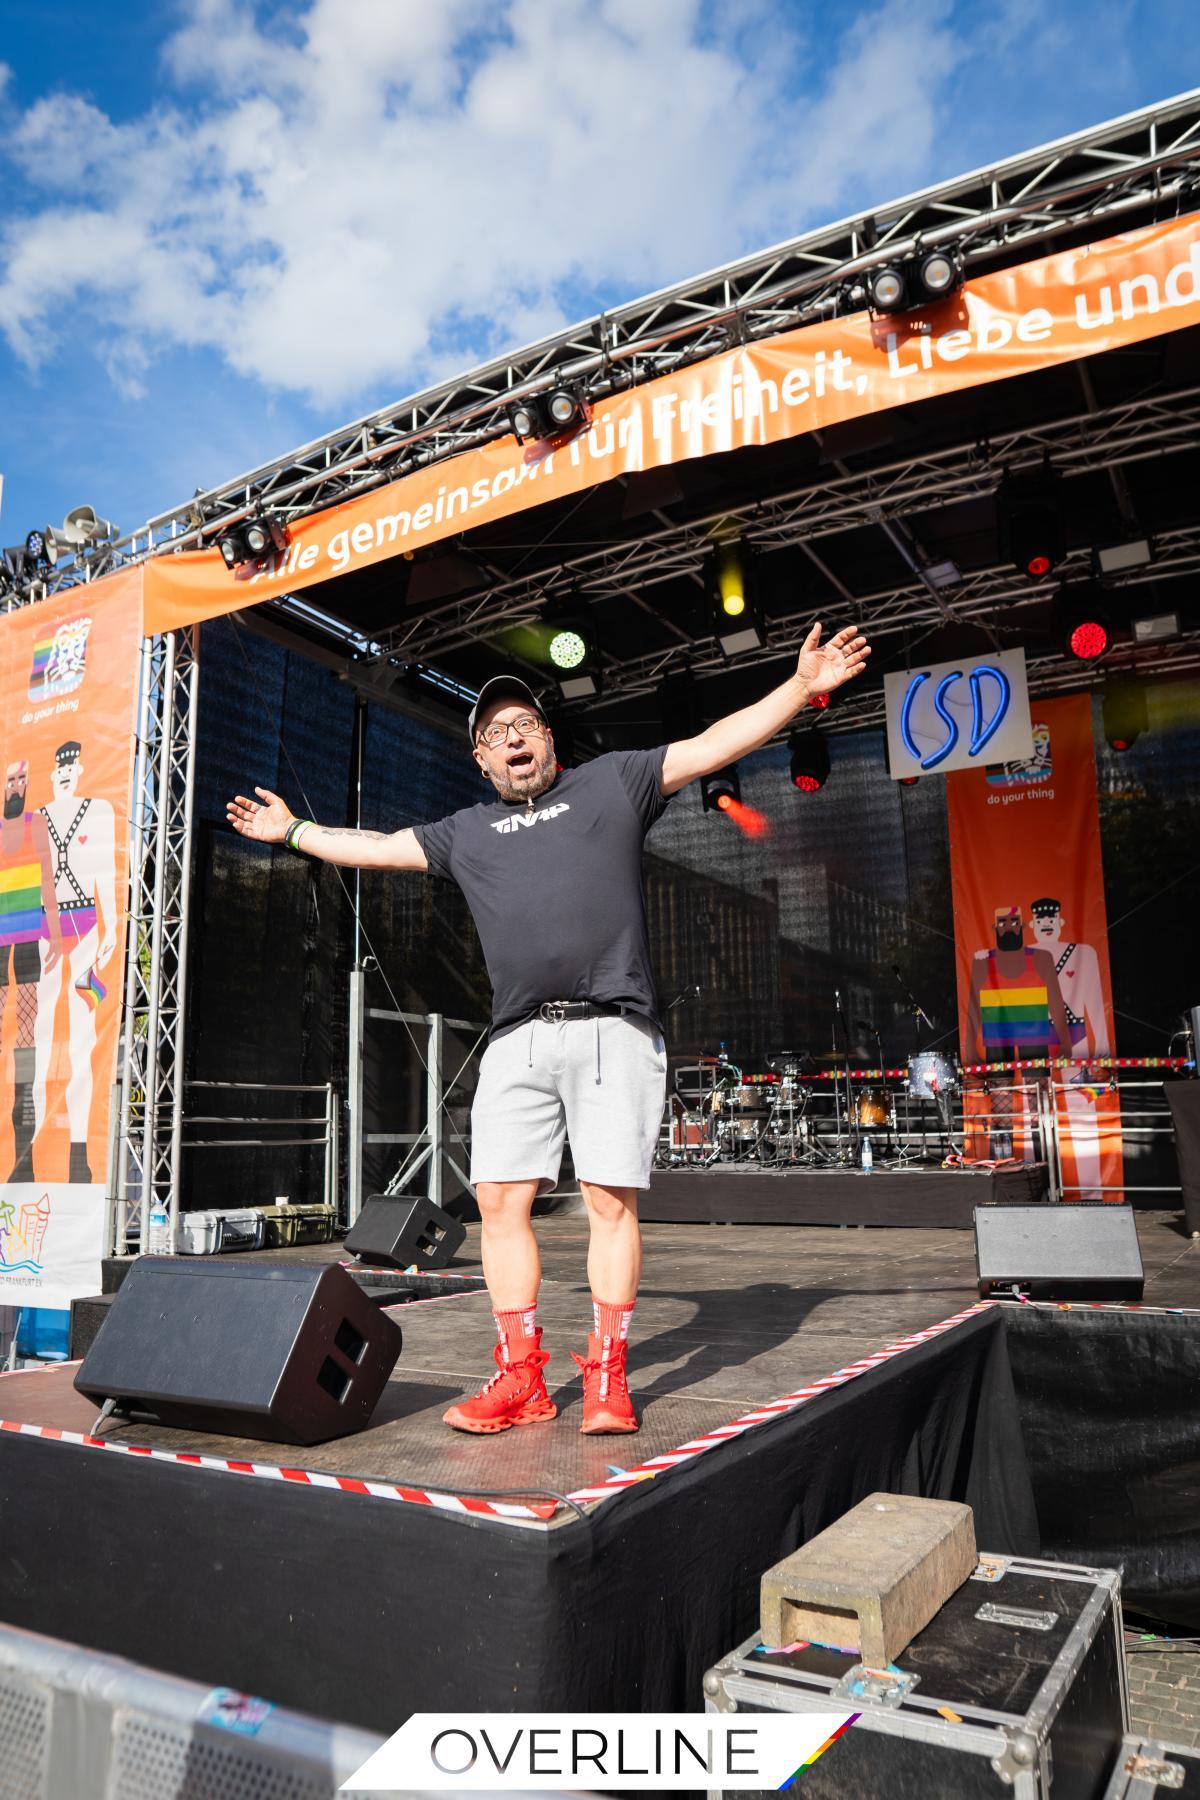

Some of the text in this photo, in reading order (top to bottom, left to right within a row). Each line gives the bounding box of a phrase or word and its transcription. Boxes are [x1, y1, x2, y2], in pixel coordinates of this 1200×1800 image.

[651, 349, 869, 440] Freiheit,
[886, 296, 1052, 379] Liebe
[1074, 242, 1200, 330] und
[22, 698, 80, 724] do your thing
[901, 665, 1011, 770] CSD
[987, 788, 1055, 806] do your thing
